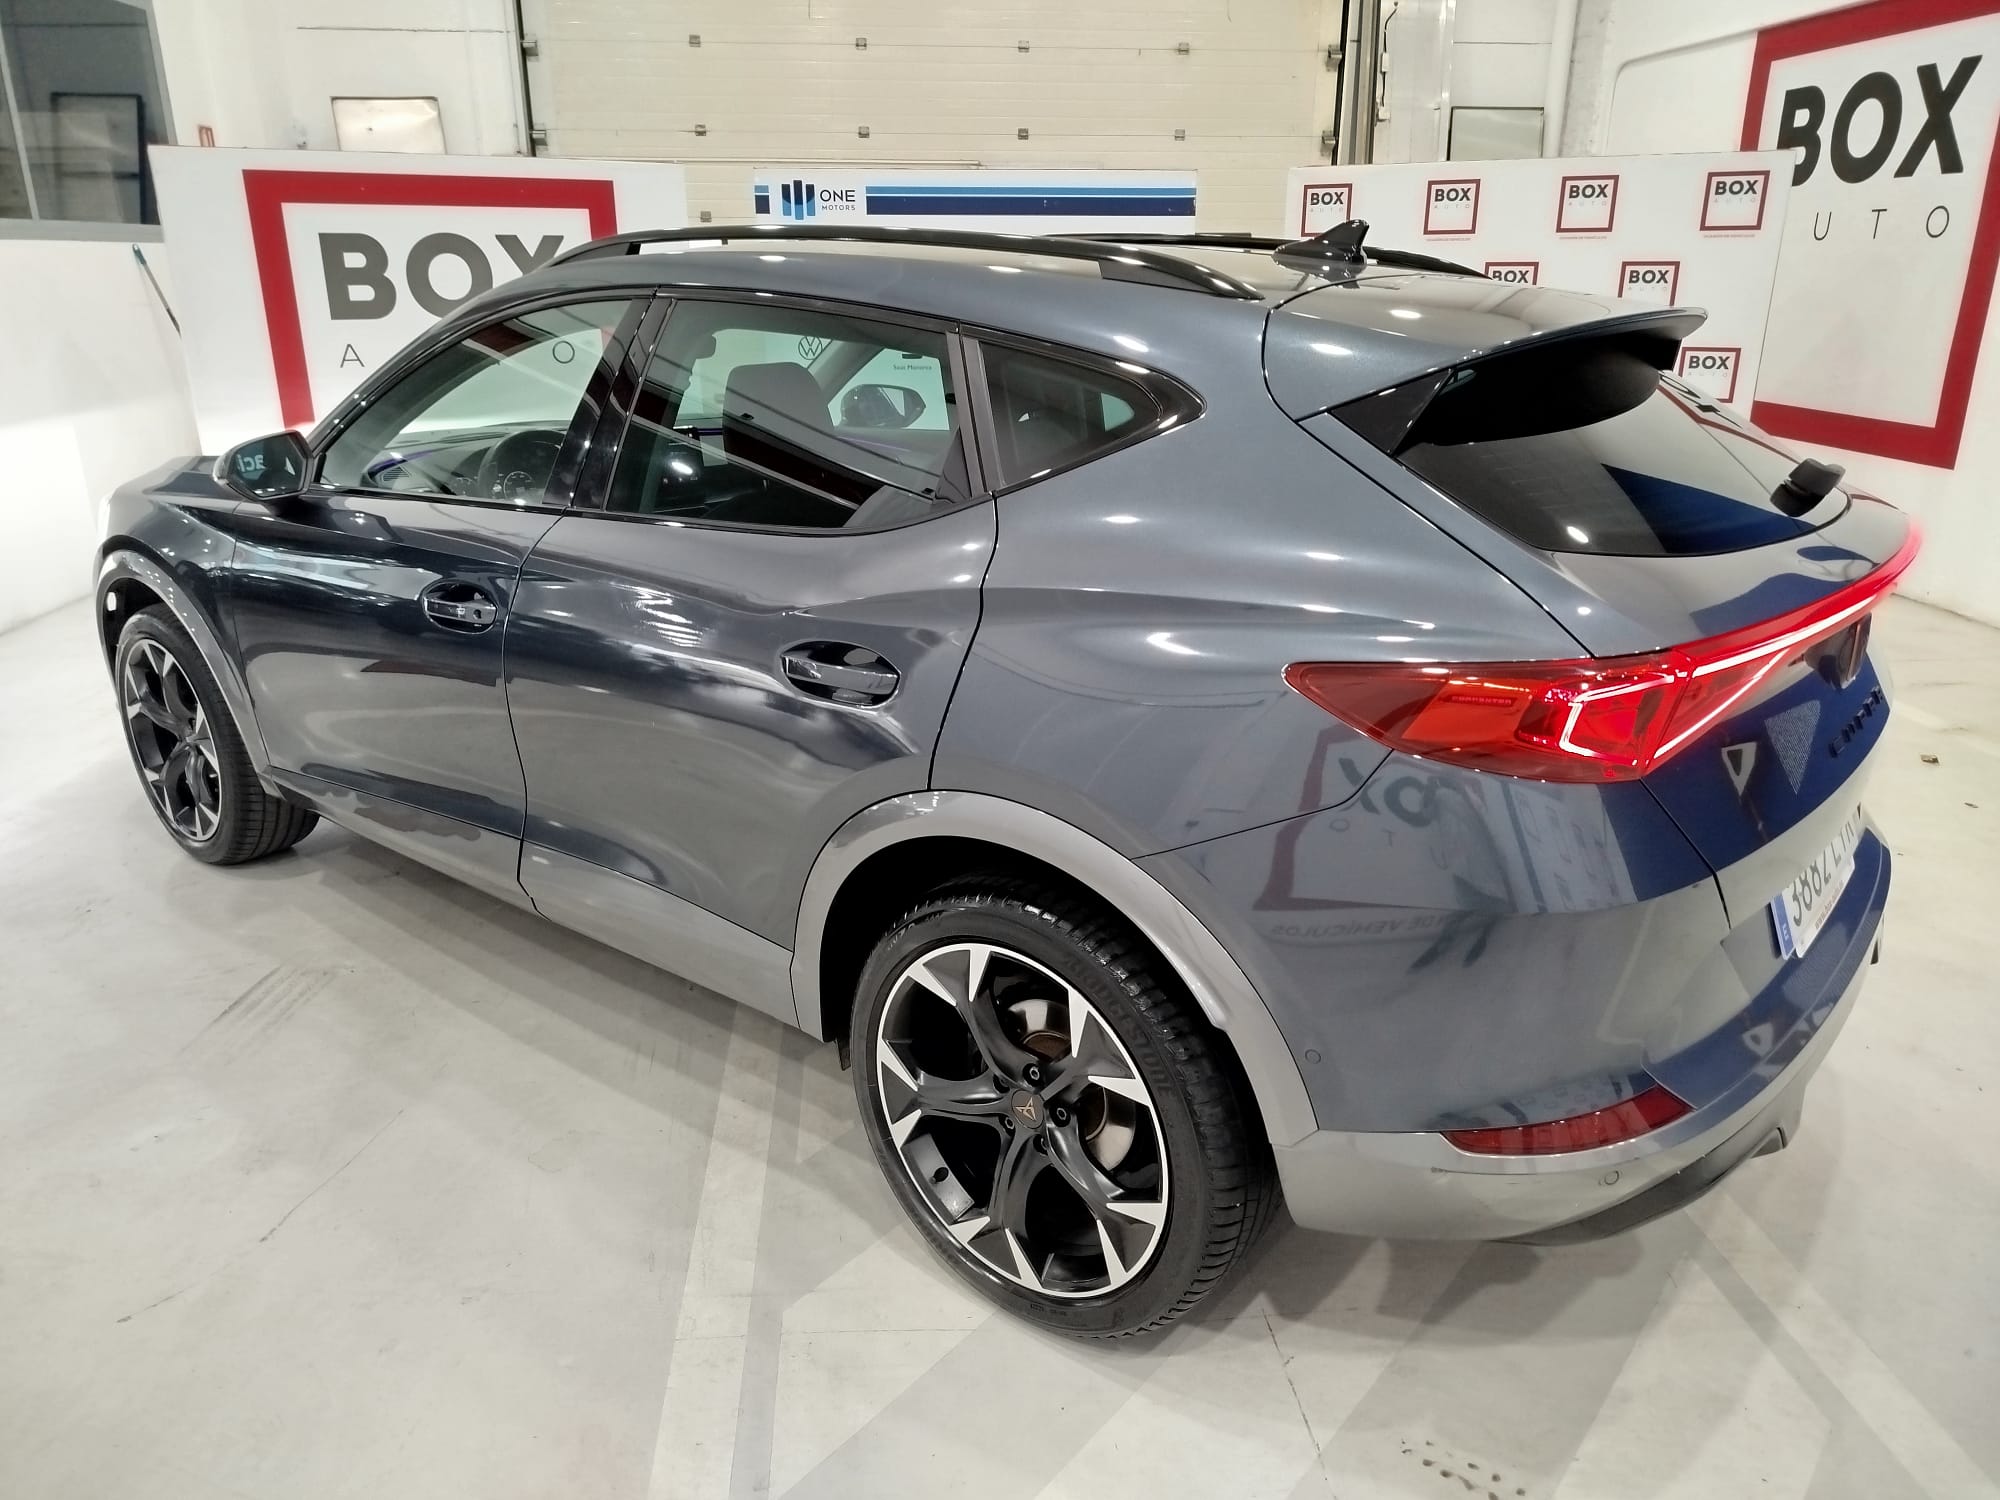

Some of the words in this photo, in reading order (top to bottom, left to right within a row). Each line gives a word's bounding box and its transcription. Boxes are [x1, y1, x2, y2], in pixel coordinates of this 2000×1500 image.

[1776, 54, 1984, 188] BOX
[819, 189, 856, 202] ONE
[1434, 187, 1472, 202] BOX
[1569, 183, 1609, 199] BOX
[1714, 180, 1759, 196] BOX
[1310, 191, 1345, 206] BOX
[1813, 205, 1950, 241] UTO
[1628, 269, 1670, 284] BOX
[1688, 355, 1730, 370] BOX
